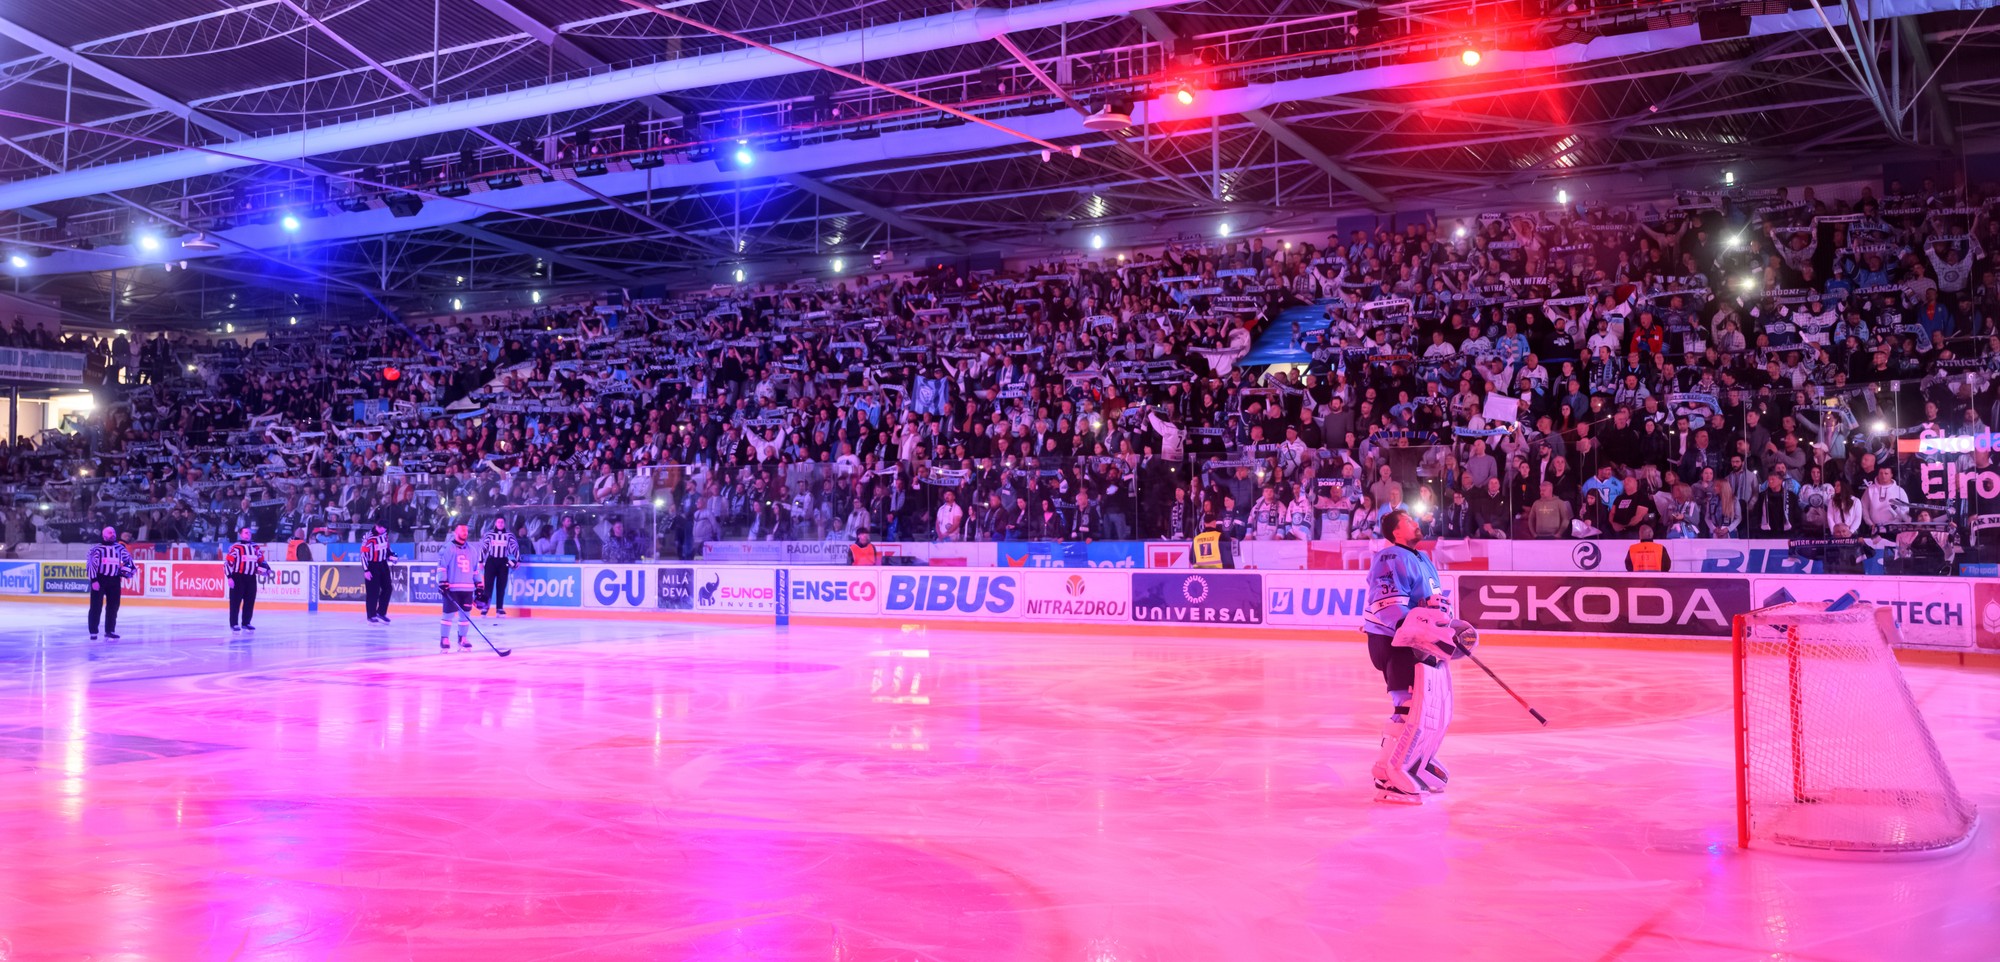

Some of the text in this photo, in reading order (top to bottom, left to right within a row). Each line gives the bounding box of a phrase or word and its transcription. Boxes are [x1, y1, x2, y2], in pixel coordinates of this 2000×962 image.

[149, 566, 167, 587] CS
[182, 577, 224, 591] HASKON
[662, 572, 690, 585] MILÁ
[45, 580, 63, 591] Dolné
[507, 575, 575, 602] ipsport
[662, 587, 690, 598] DEVA
[721, 587, 774, 599] SUNOB
[792, 580, 876, 602] ENSECO
[1381, 583, 1399, 596] 32
[886, 575, 1017, 614] BIBUS
[1301, 588, 1367, 616] UNI
[1026, 600, 1126, 617] NITRAZDROJ
[1135, 606, 1259, 623] UNIVERSAL
